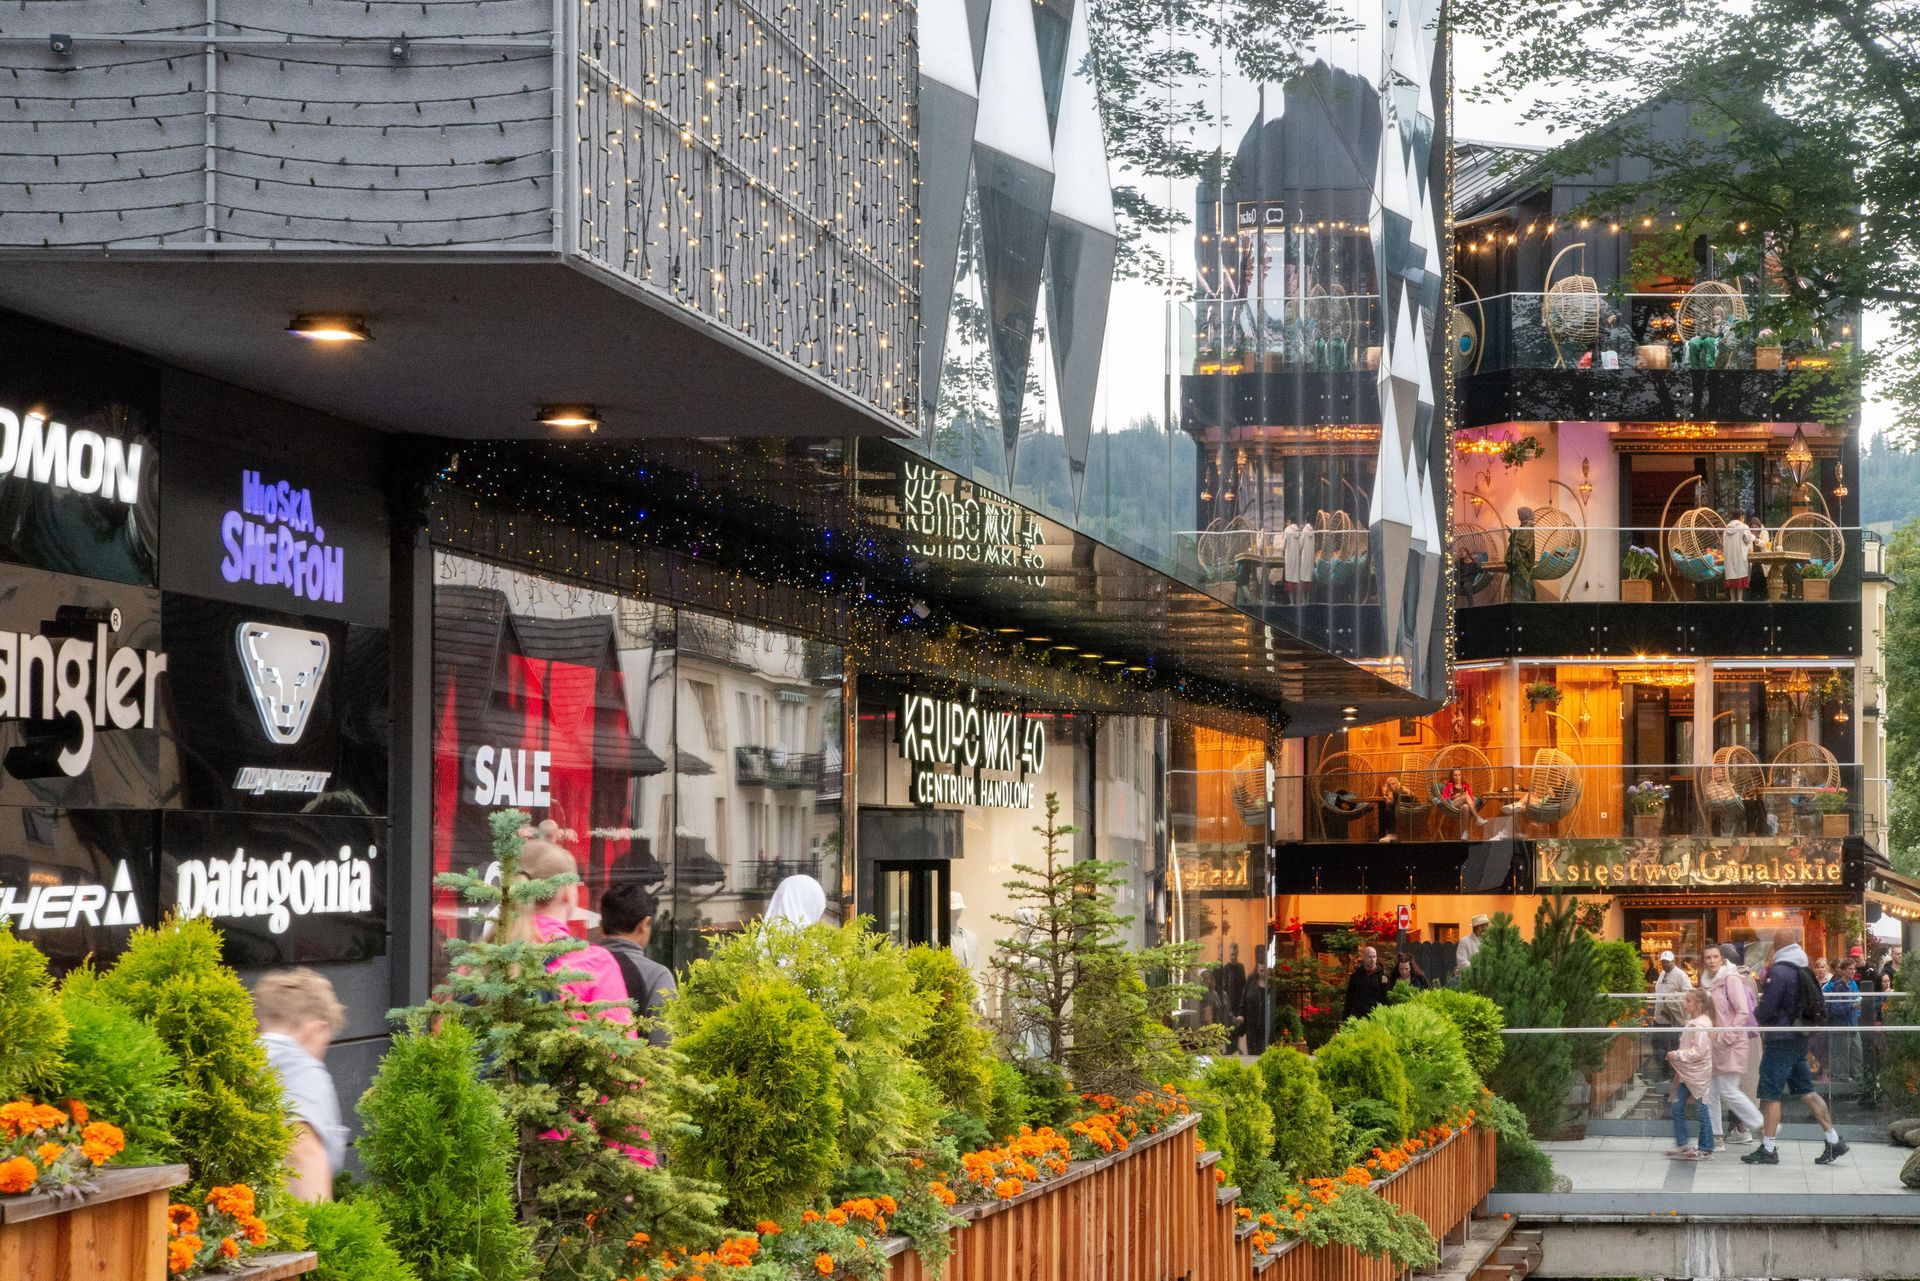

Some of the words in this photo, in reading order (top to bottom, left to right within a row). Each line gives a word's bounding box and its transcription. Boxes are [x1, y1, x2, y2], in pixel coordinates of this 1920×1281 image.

[221, 510, 344, 604] SMERFÓW
[904, 688, 1017, 772] KRUPÓWKI
[1021, 717, 1045, 775] 40
[474, 744, 551, 807] SALE
[918, 771, 975, 805] CENTRUM
[980, 778, 1034, 809] HANDLOWE
[176, 845, 372, 934] patagonia
[1538, 849, 1682, 885] Księstwo
